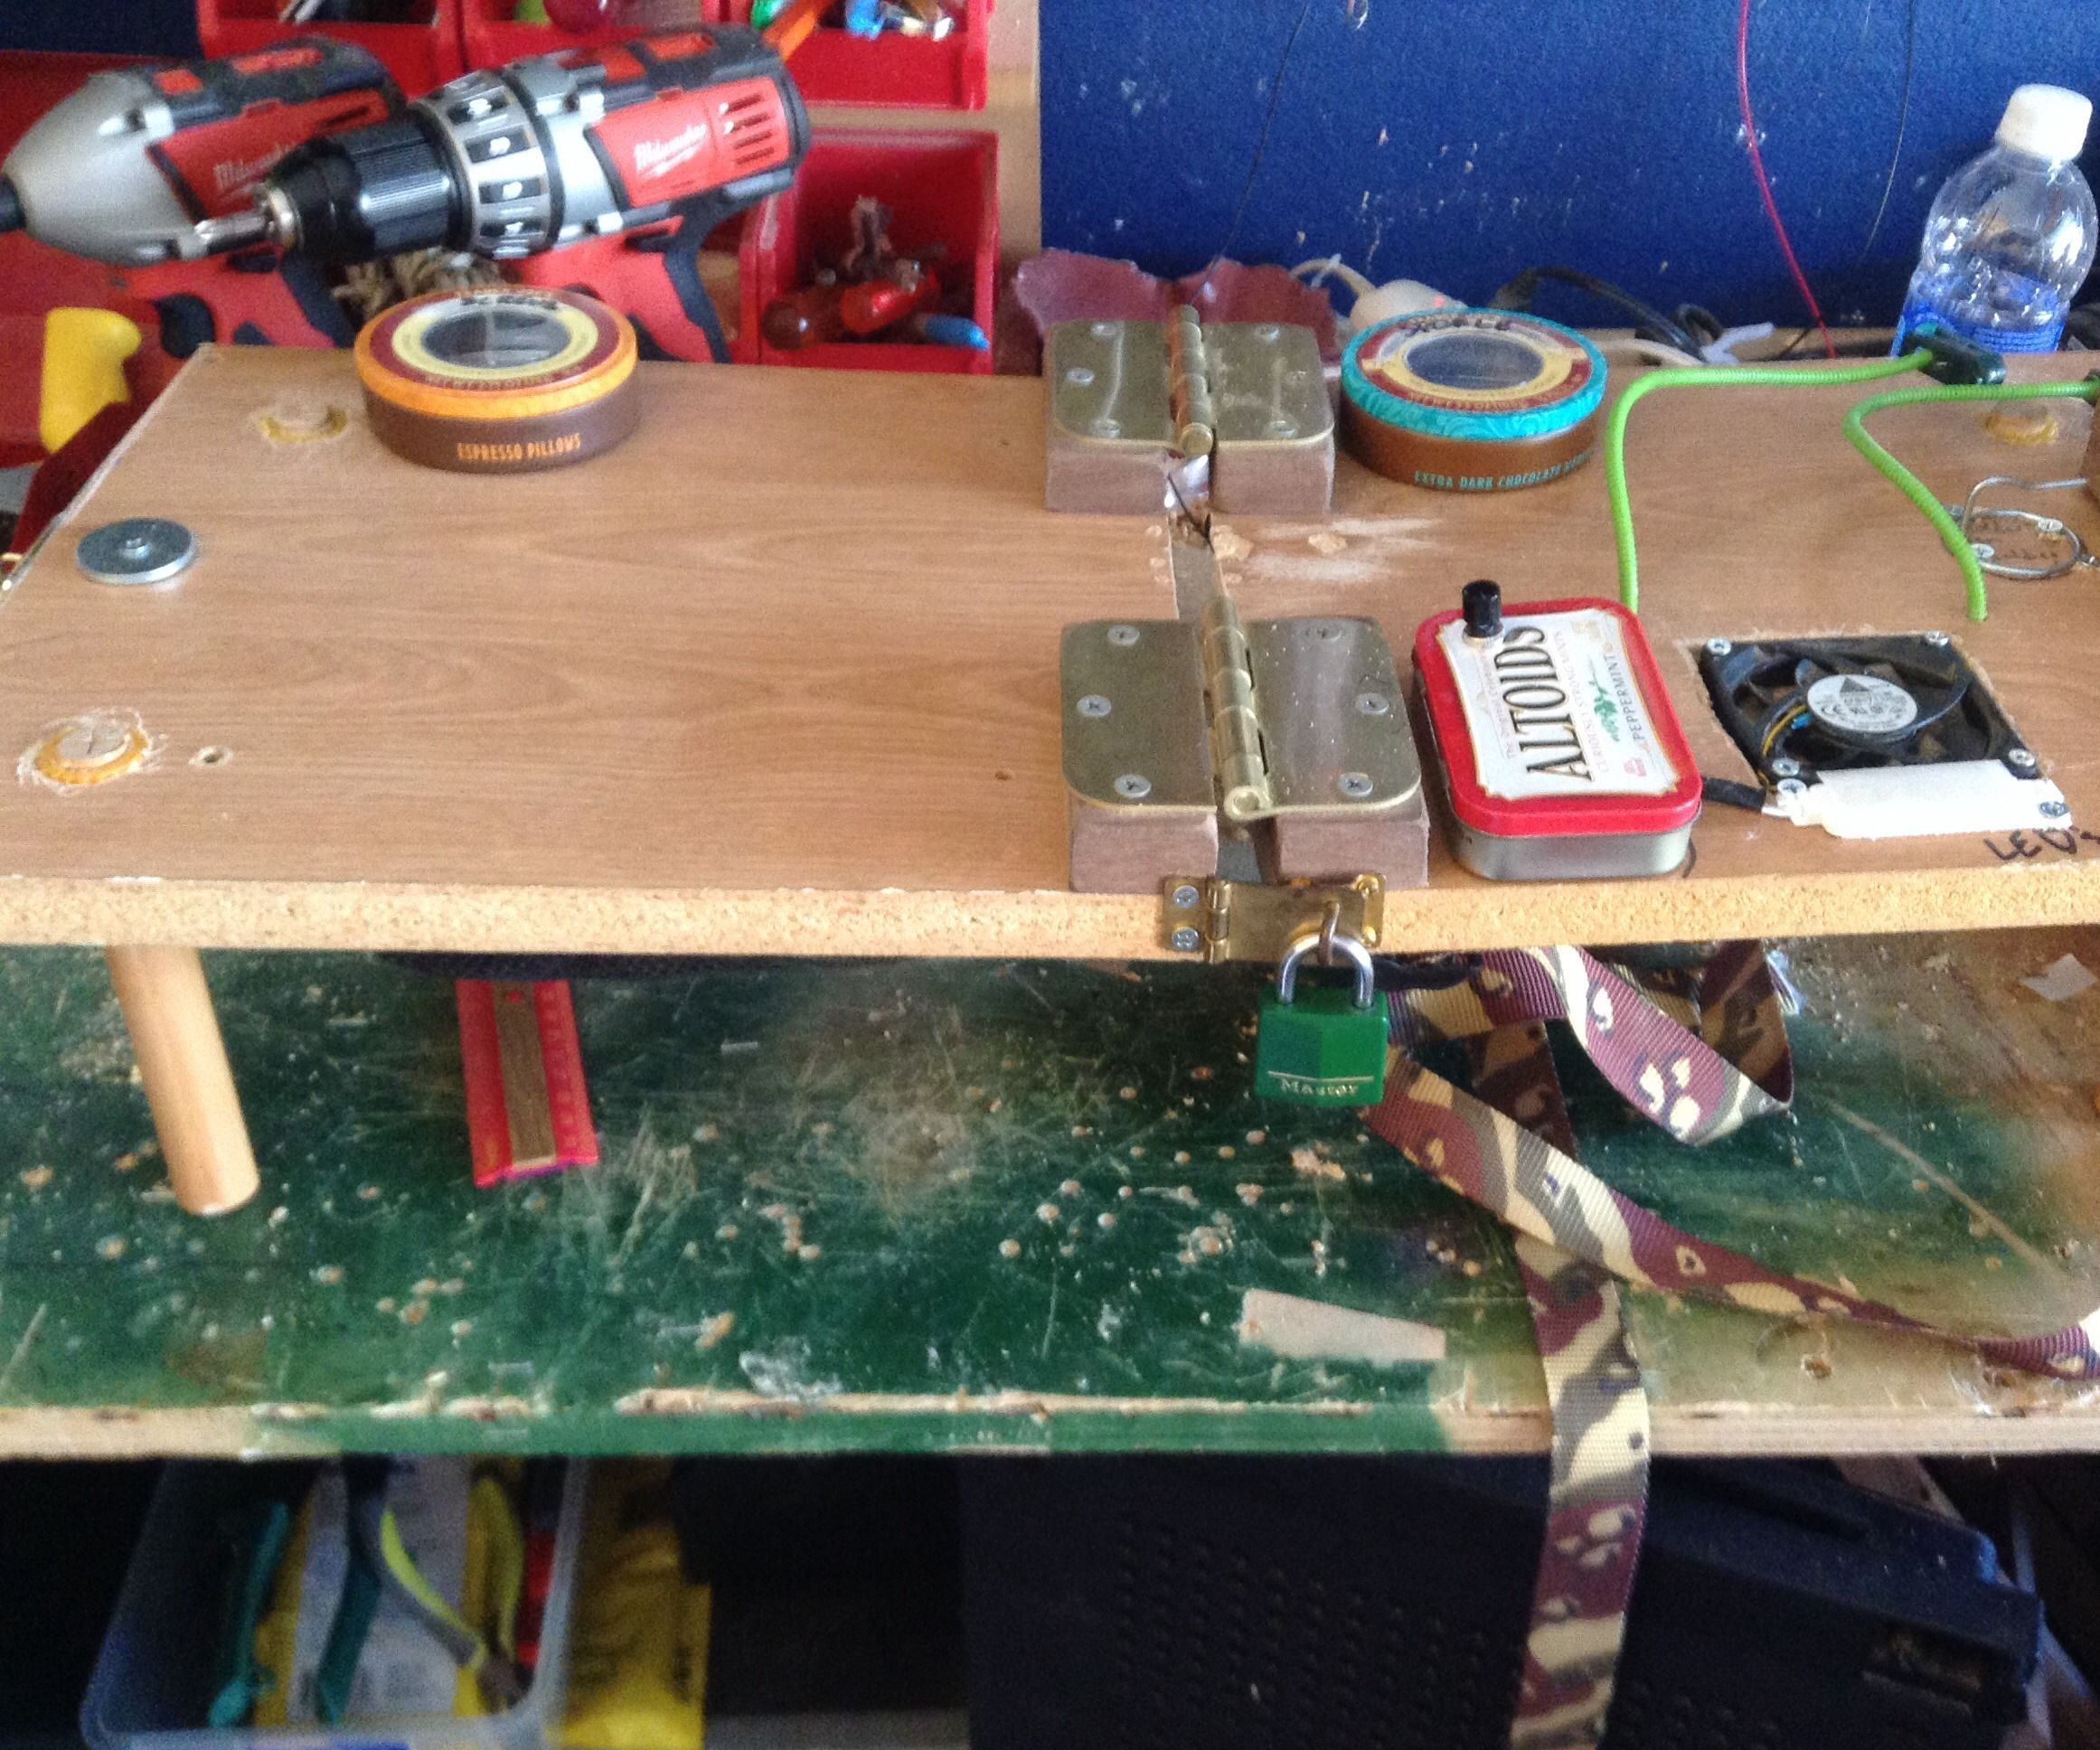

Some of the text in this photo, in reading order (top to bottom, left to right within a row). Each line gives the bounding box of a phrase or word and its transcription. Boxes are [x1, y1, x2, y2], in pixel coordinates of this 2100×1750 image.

[457, 432, 581, 463] ESPRESSO PILLOWS
[1413, 469, 1455, 491] EXTRA
[1458, 475, 1494, 491] DARK
[1493, 626, 1594, 782] ALTOIDS
[1603, 653, 1646, 742] PEPPERMINT
